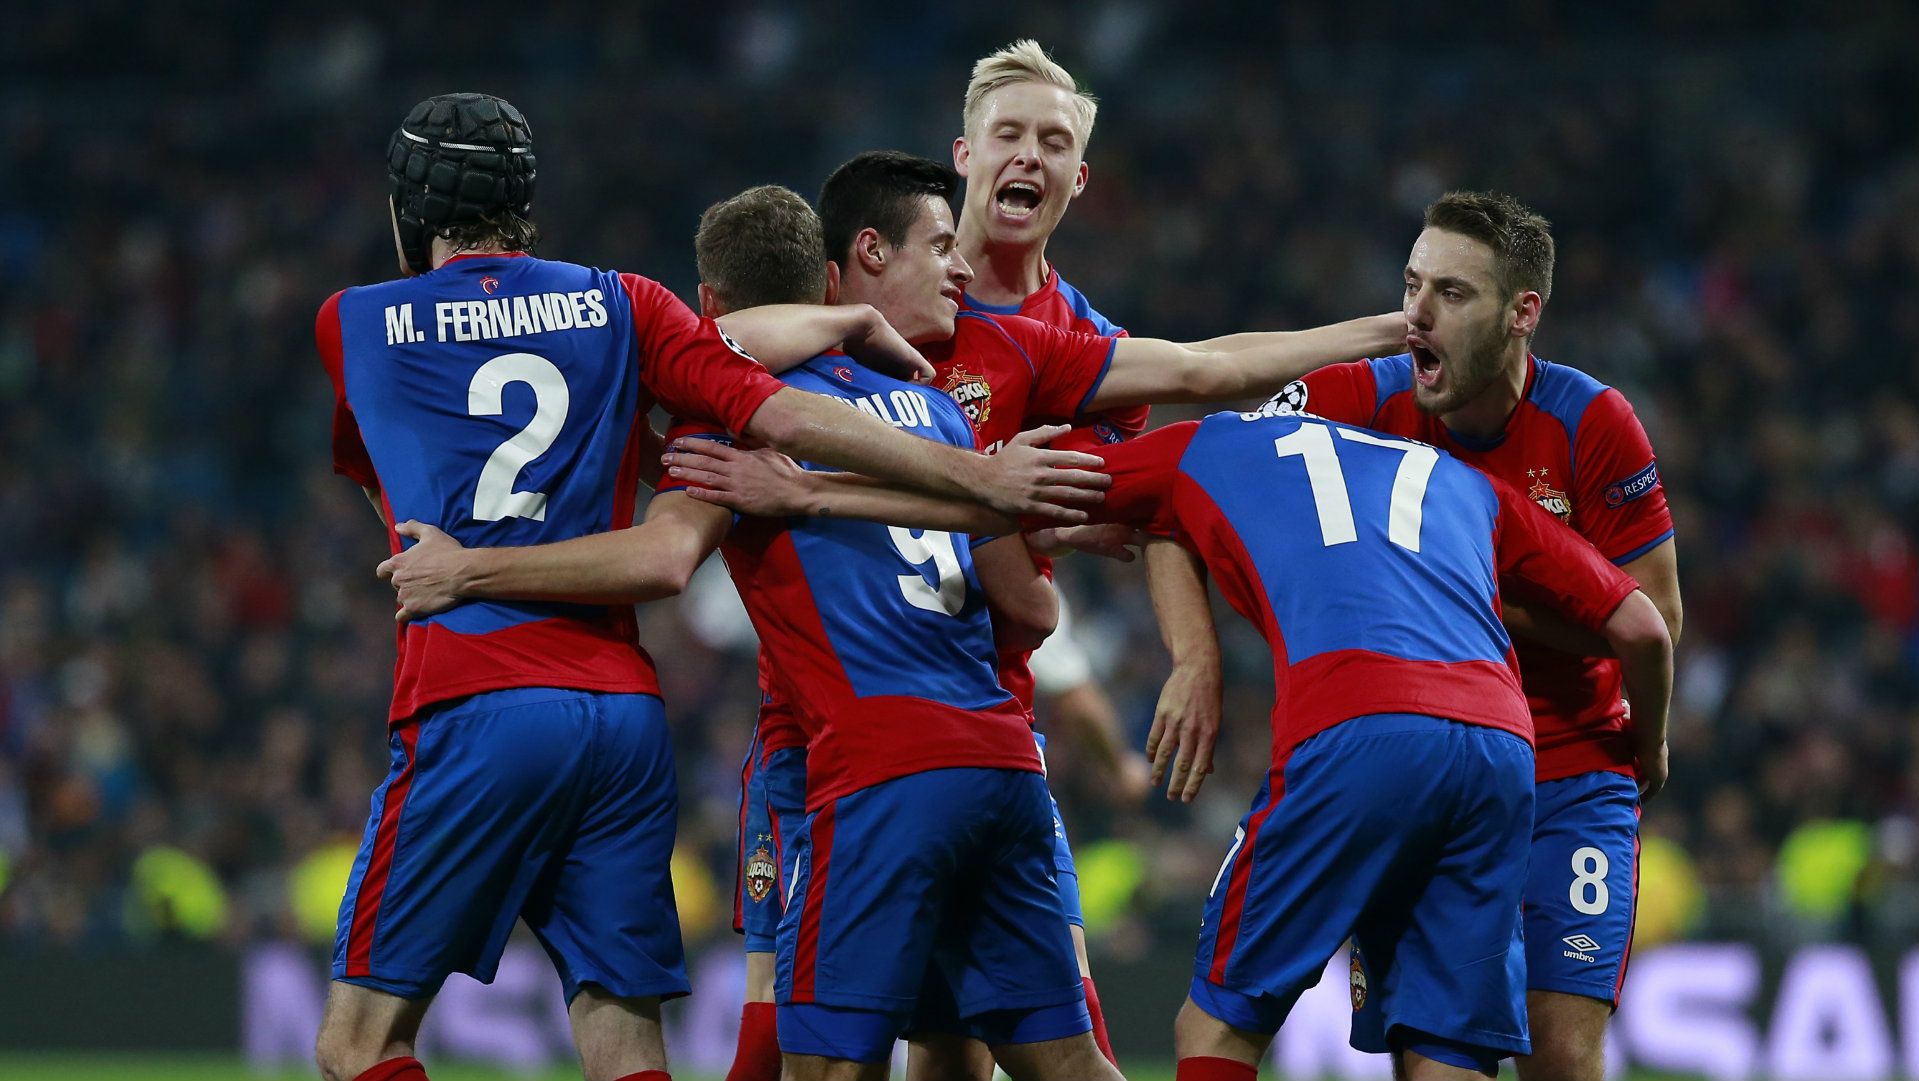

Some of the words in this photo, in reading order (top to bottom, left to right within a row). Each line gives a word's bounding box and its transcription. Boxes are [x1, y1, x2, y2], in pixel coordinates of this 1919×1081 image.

[385, 304, 424, 345] M.
[436, 288, 608, 342] FERNANDES
[468, 353, 569, 522] 2
[820, 390, 932, 427] ALOV
[1274, 422, 1440, 553] 17
[887, 526, 965, 617] 9
[1569, 846, 1609, 915] 8
[1563, 950, 1595, 963] umbro
